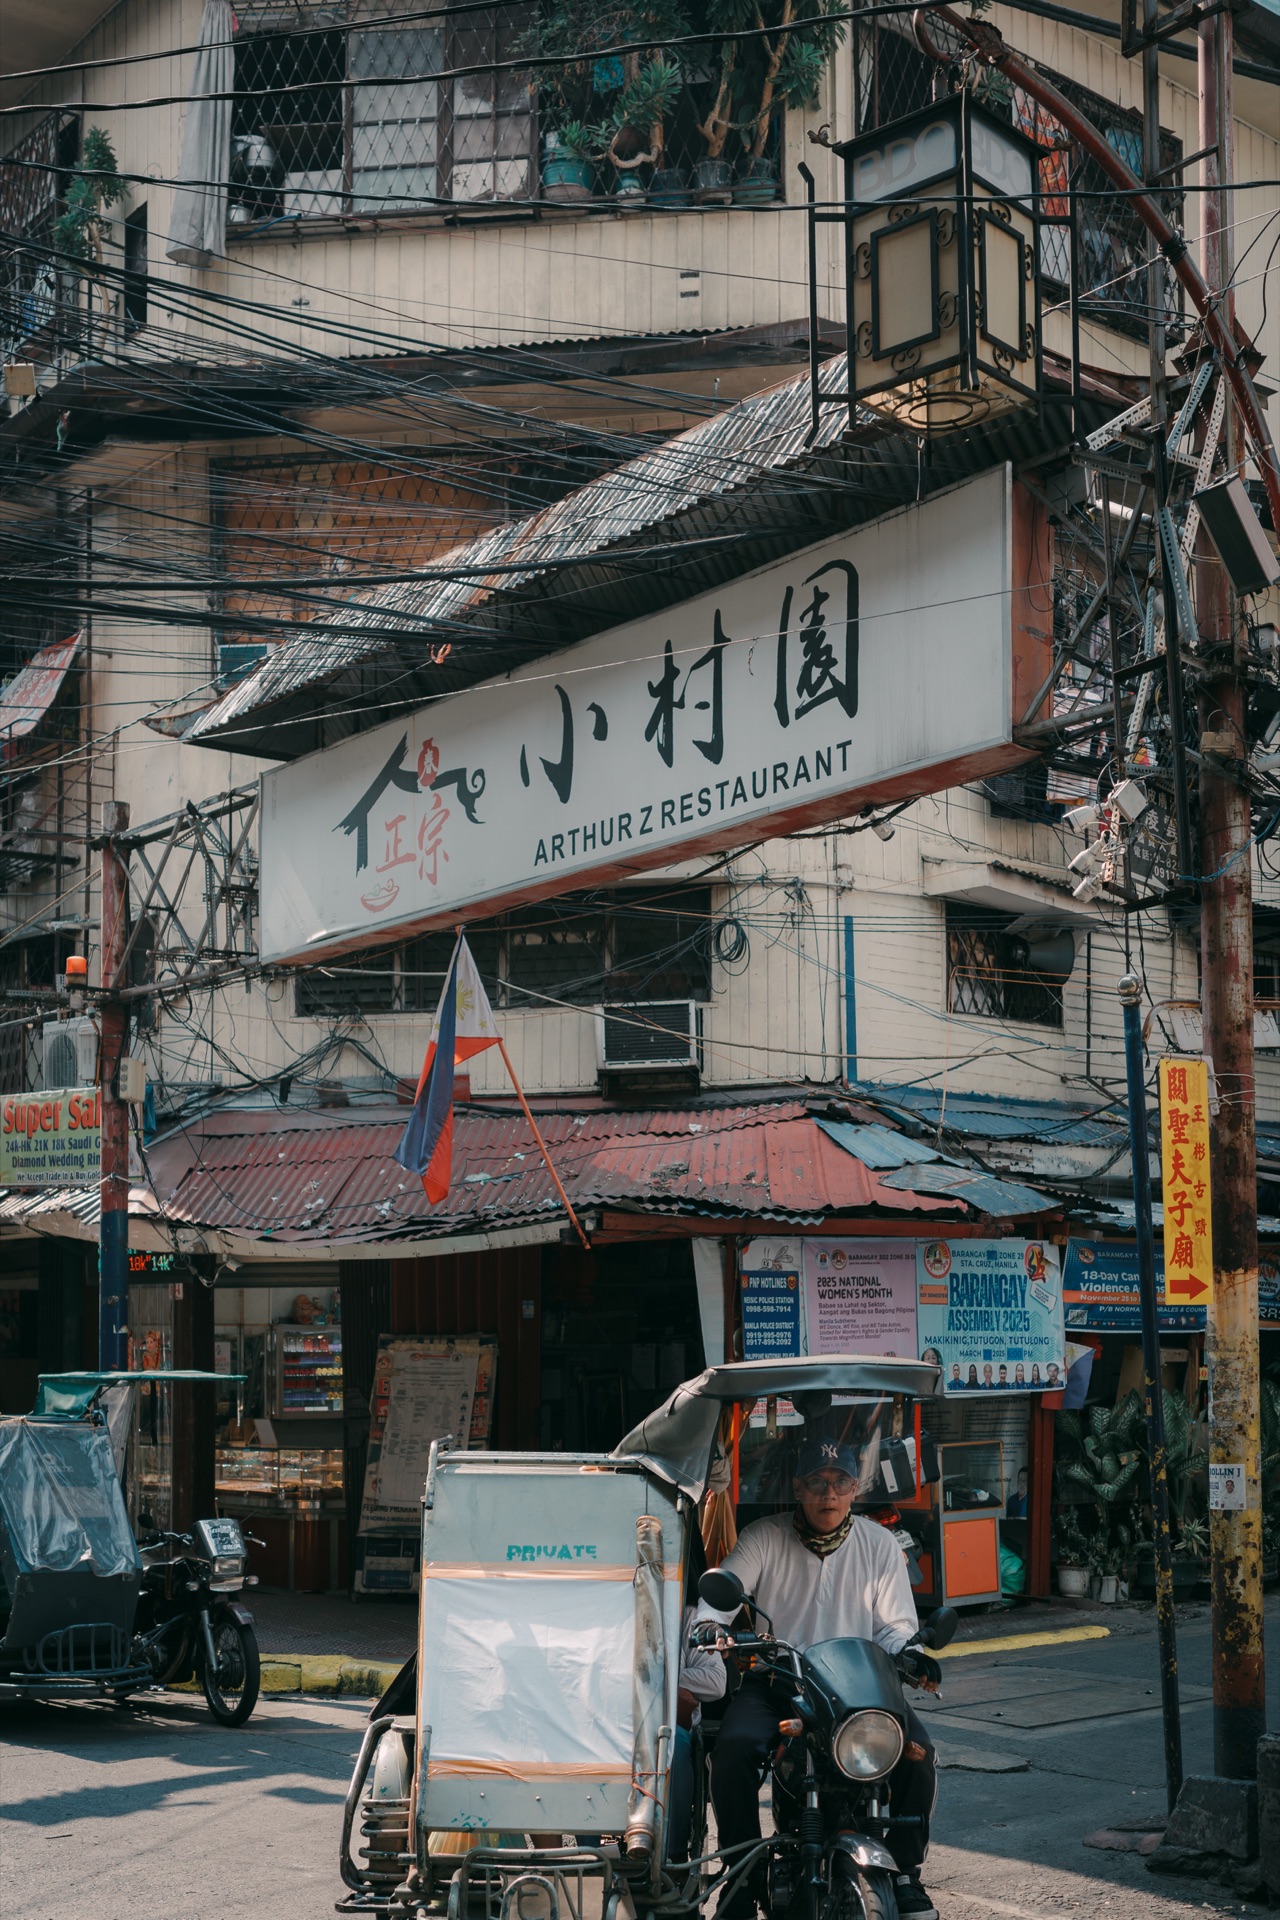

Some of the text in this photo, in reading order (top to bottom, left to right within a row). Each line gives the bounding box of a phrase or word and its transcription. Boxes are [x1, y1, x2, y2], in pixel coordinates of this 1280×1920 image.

[853, 120, 956, 199] BDO
[971, 122, 1032, 197] BDO
[520, 559, 859, 804] 小村園
[534, 739, 852, 867] ARTHUR Z RESTAURANT
[3, 1090, 100, 1140] Super Sal
[6, 1139, 31, 1153] 24k-HK
[34, 1139, 49, 1152] 21K
[52, 1138, 66, 1150] 18K
[68, 1136, 92, 1150] Saudi
[12, 1152, 100, 1169] Diamond Wedding Rin
[1167, 1066, 1194, 1269] 關聖夫子廟
[17, 1173, 25, 1181] We
[27, 1172, 44, 1182] Accept
[46, 1172, 61, 1181] Trade
[62, 1172, 69, 1181] In
[70, 1172, 74, 1181] &
[75, 1171, 86, 1182] Buy
[1191, 1104, 1207, 1236] 王彬古蹟
[952, 1250, 1024, 1260] BARANGAY ZONE 29
[961, 1259, 974, 1267] STA.
[976, 1260, 993, 1269] CRUZ,
[749, 1277, 787, 1288] PNP HOTLINES
[817, 1276, 882, 1288] 2025 NATIONAL
[1081, 1270, 1118, 1282] 18-Day
[818, 1288, 893, 1300] WOMEN'S MONTH
[950, 1272, 1028, 1308] BARANGAY
[1080, 1282, 1130, 1293] Violence
[759, 1296, 774, 1304] POLICE
[775, 1296, 794, 1304] STATION
[1080, 1294, 1120, 1302] November
[760, 1322, 775, 1330] POLICE
[776, 1322, 795, 1330] DISTRICT
[948, 1309, 1030, 1332] ASSEMBLY 2025
[1009, 1336, 1050, 1346] TUTULONG
[959, 1349, 982, 1357] MARCH
[992, 1349, 1005, 1357] 2025
[1024, 1349, 1033, 1357] PM
[821, 1443, 839, 1459] NY
[506, 1543, 597, 1561] PRIVATE
